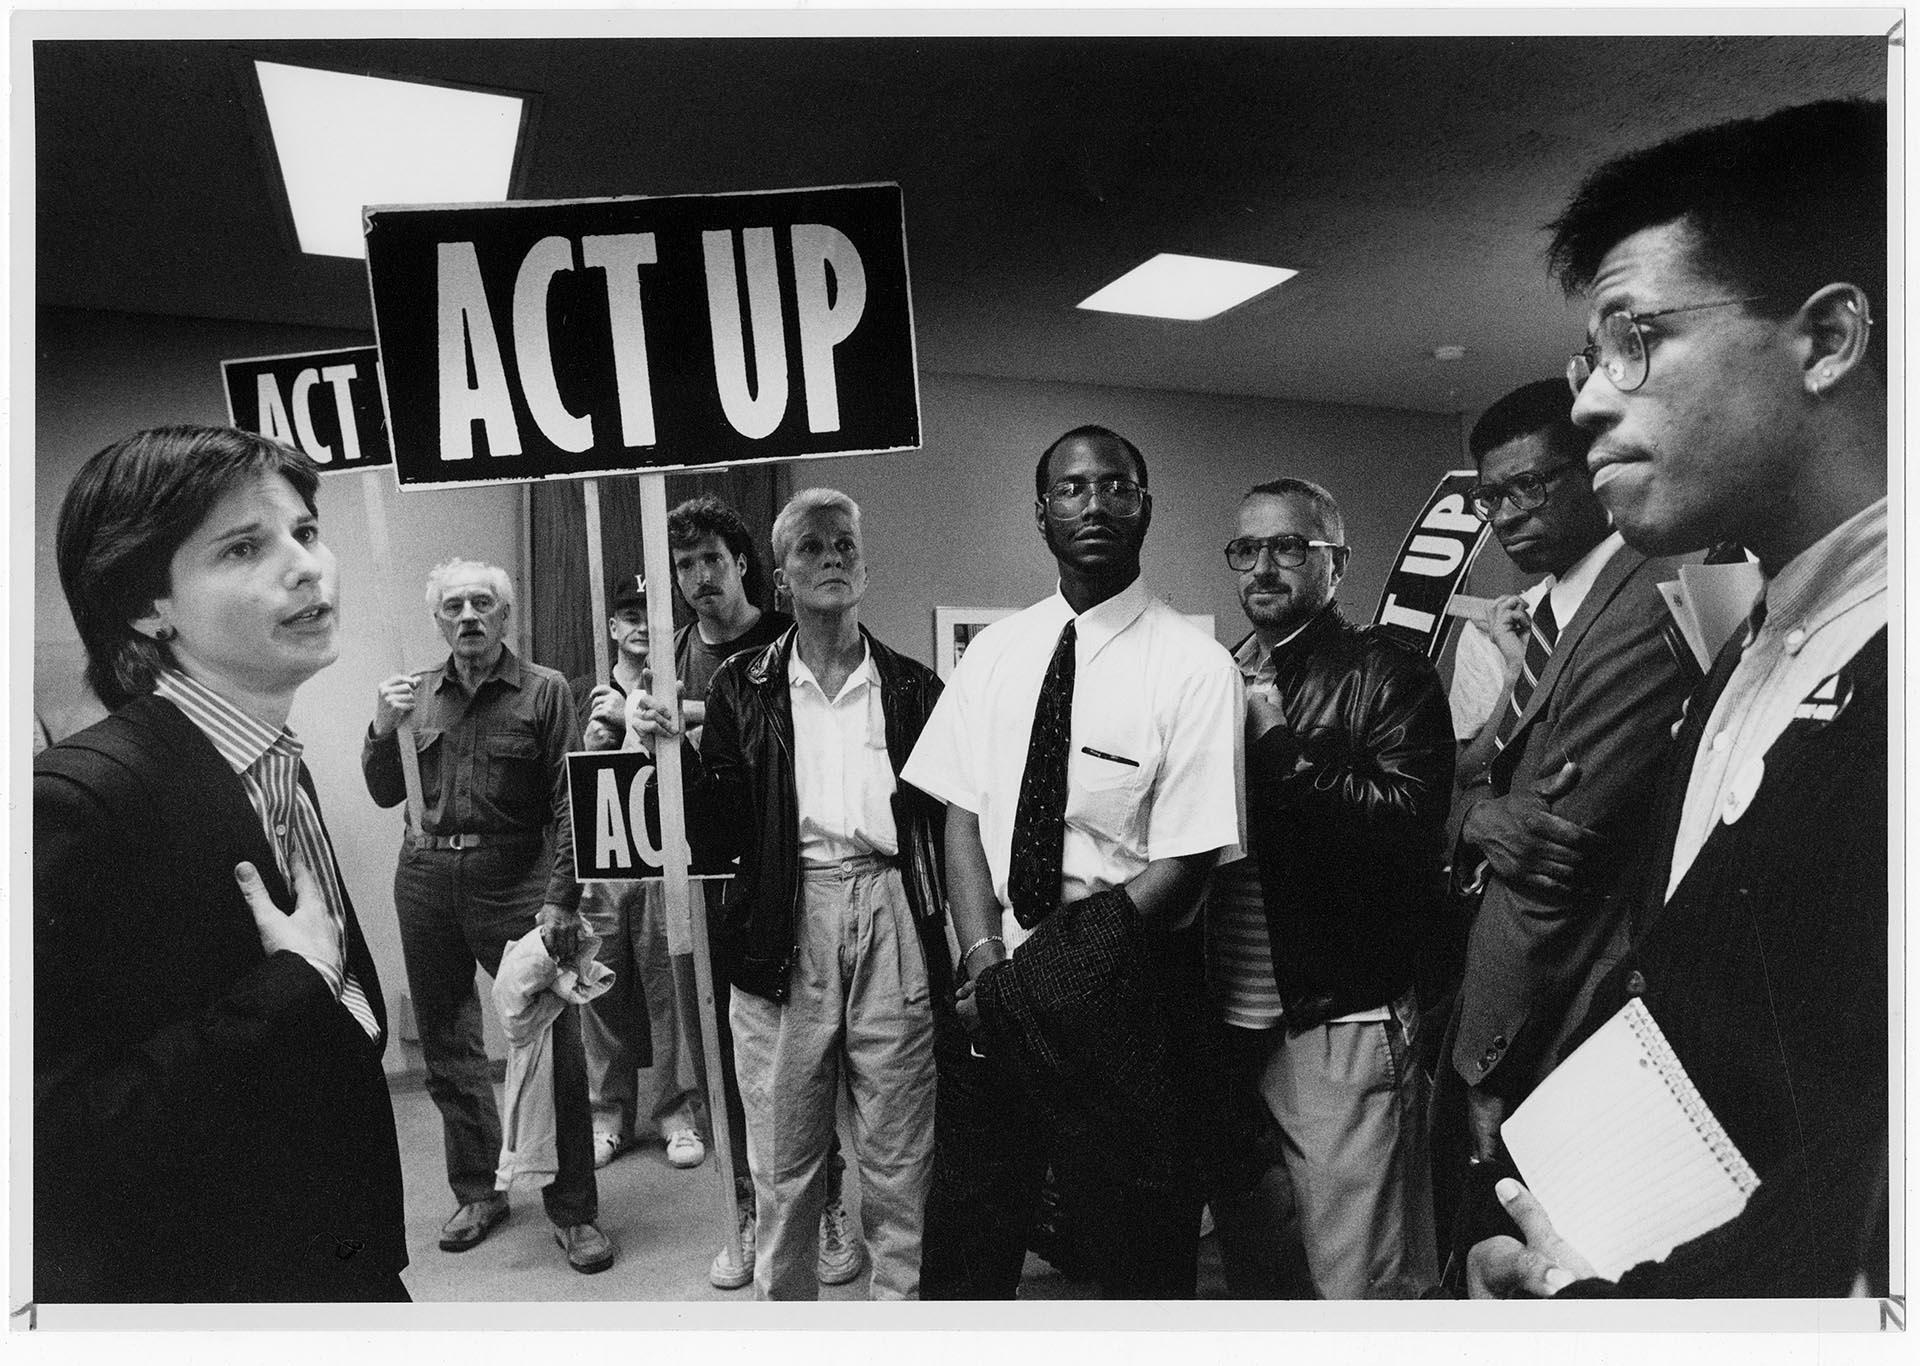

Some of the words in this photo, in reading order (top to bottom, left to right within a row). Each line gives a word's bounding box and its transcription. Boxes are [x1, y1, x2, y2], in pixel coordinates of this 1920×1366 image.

[437, 232, 657, 461] ACT
[702, 224, 866, 439] UP
[257, 364, 362, 464] ACT
[1400, 494, 1482, 577] UP
[596, 765, 692, 868] AC
